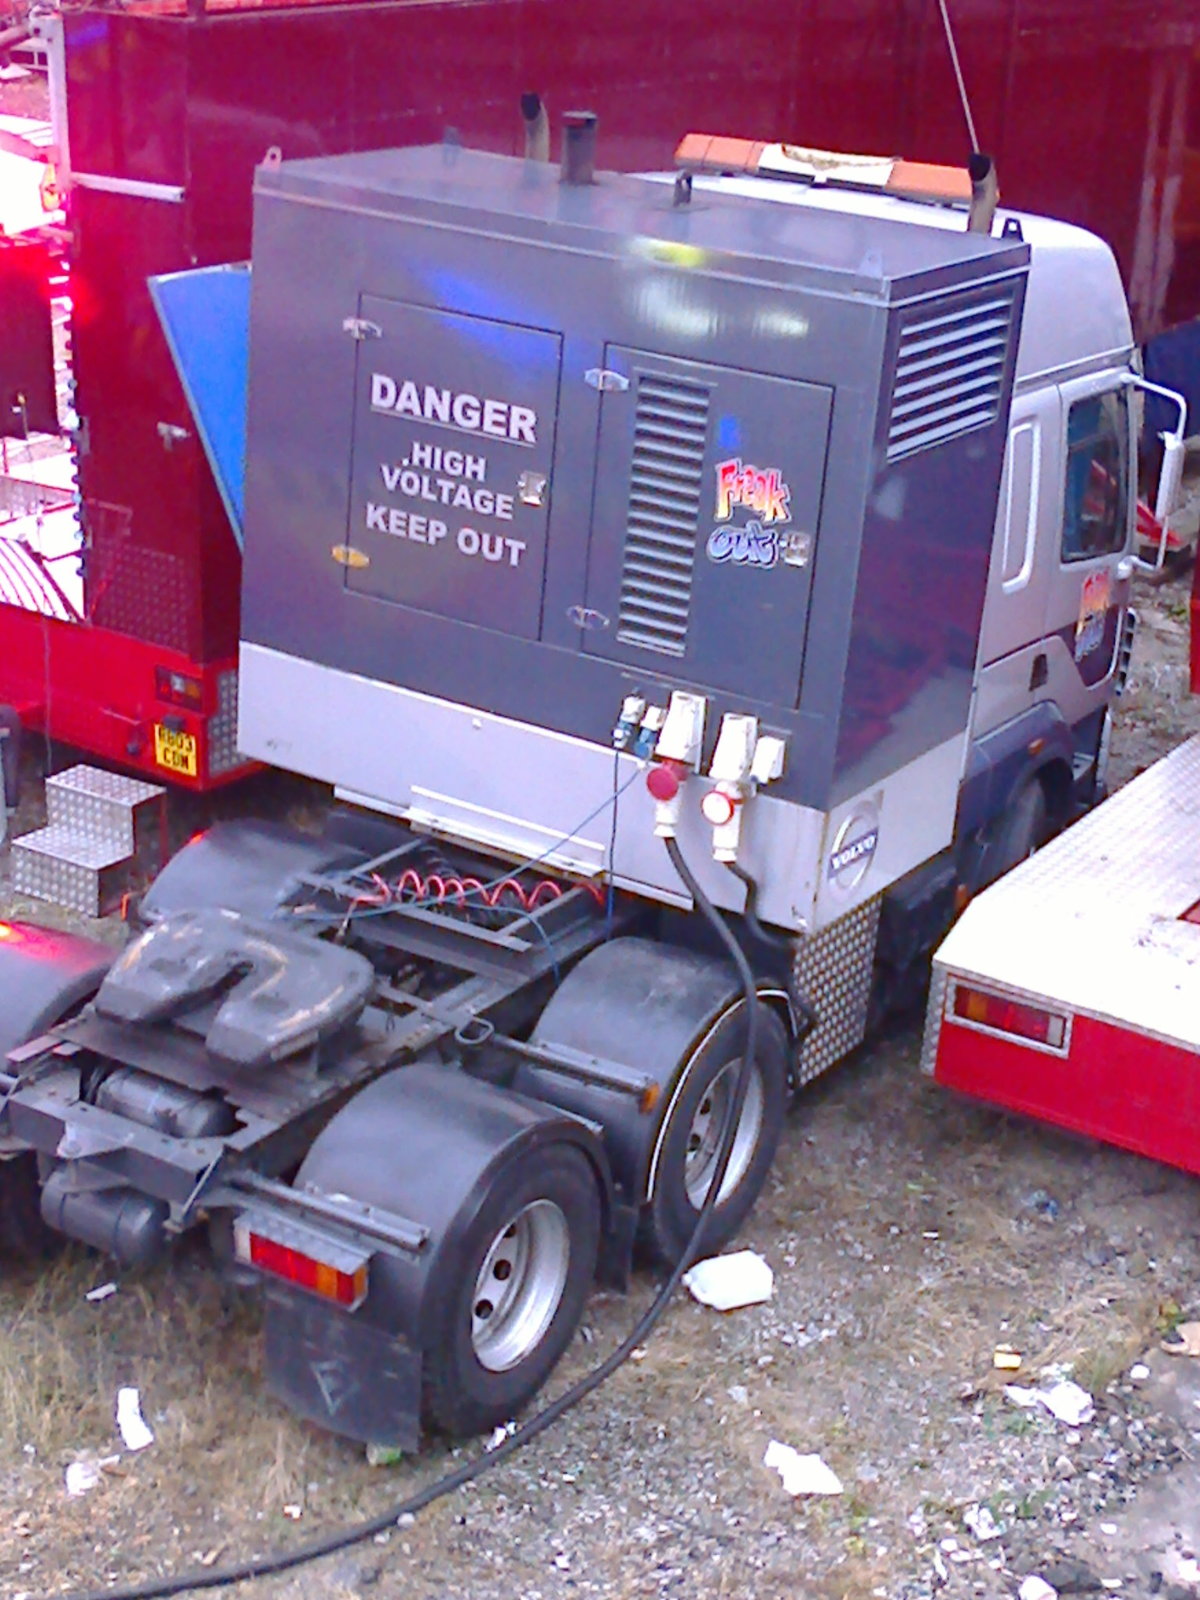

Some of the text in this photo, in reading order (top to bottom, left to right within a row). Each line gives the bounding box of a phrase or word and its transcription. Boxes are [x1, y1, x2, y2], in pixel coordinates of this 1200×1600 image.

[371, 373, 537, 443] DANGER
[381, 465, 513, 520] VOLTAGE
[366, 502, 526, 566] KEEP OUT
[831, 834, 876, 870] VOLVO
